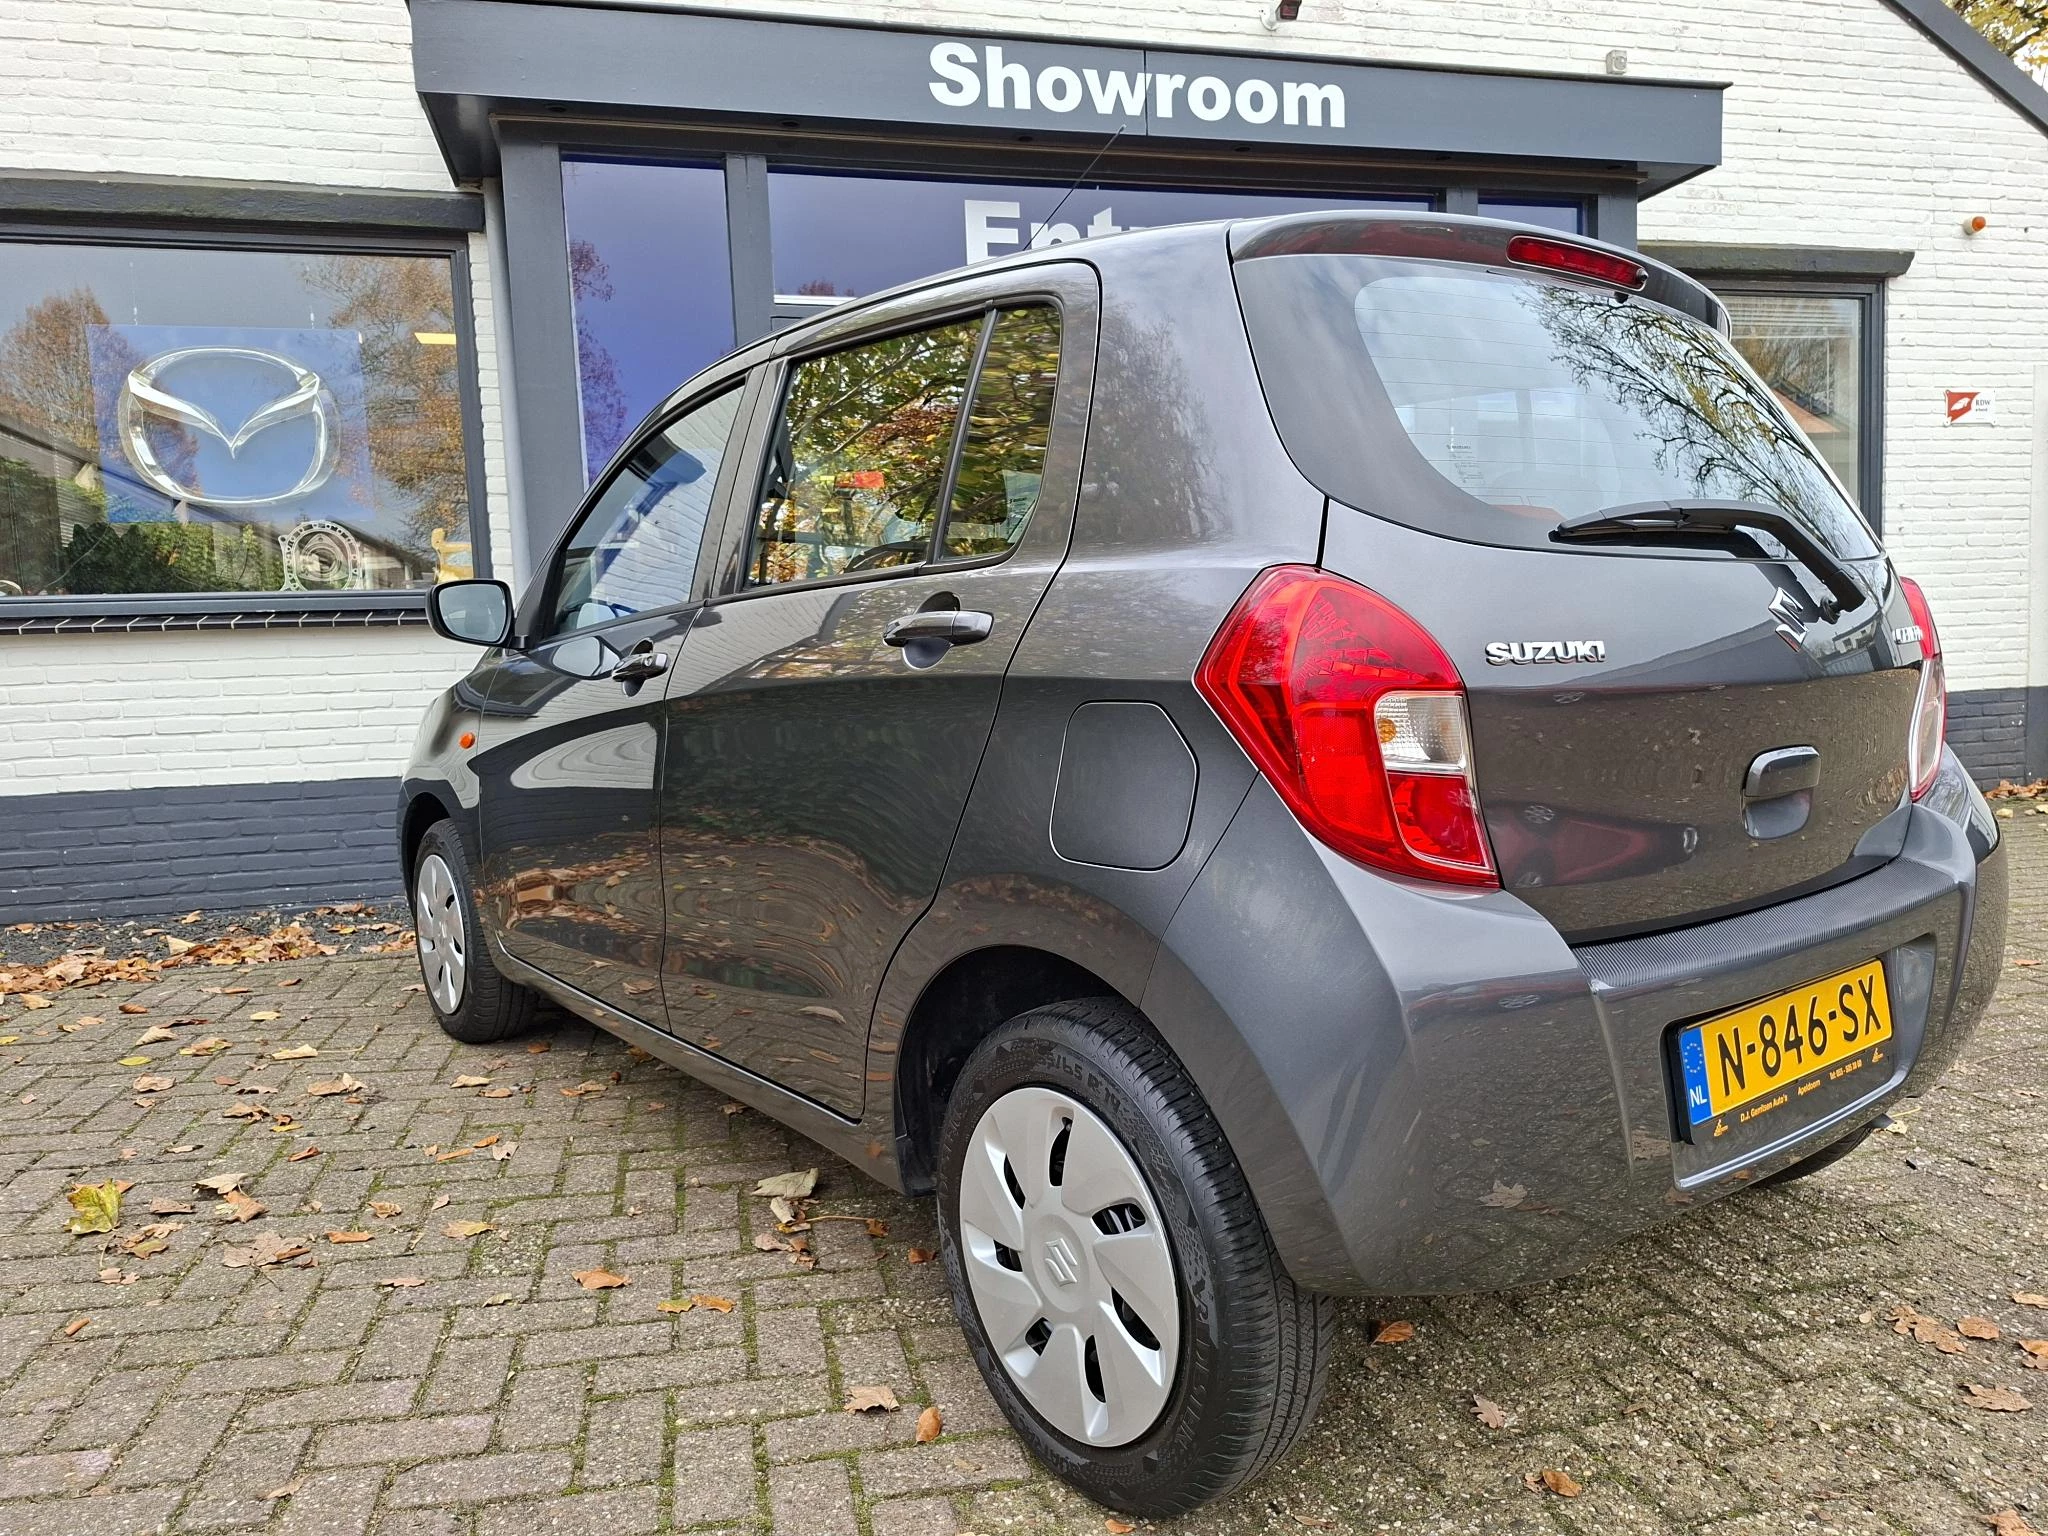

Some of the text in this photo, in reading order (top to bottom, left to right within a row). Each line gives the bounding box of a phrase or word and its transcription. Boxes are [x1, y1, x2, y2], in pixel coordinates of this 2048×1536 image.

[928, 42, 1346, 129] Showroom
[964, 199, 1148, 266] Ent
[1485, 640, 1606, 666] SUZUKI
[1717, 974, 1881, 1097] N-846-SX
[1689, 1086, 1707, 1109] NL
[1773, 1094, 1788, 1107] Auto's
[1797, 1079, 1821, 1097] Apeldoorn
